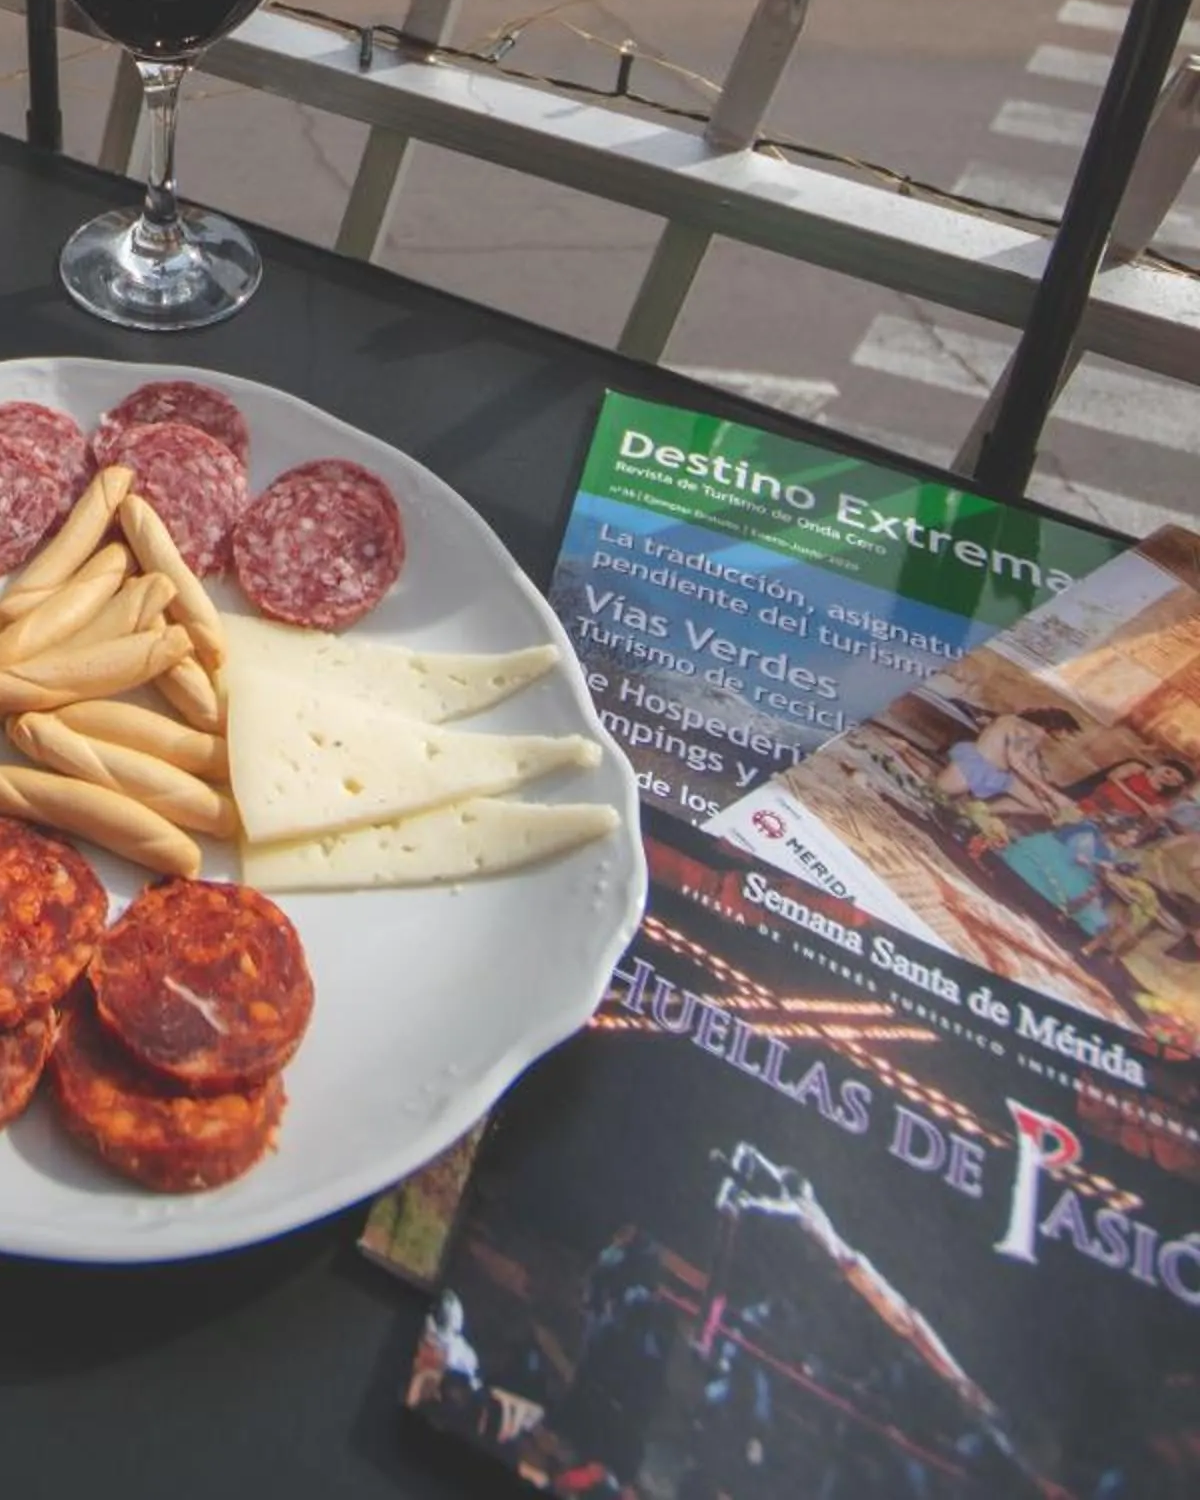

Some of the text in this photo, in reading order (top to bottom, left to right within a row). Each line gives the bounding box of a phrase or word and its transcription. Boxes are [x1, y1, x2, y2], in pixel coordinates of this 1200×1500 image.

[615, 460, 888, 556] Revista de Turismo de Onda Cero
[619, 429, 817, 509] Destino
[592, 549, 750, 617] pendiente
[757, 604, 809, 638] del
[599, 522, 635, 550] La
[644, 536, 816, 615] traducción,
[576, 613, 856, 734] Turismo de recicl
[584, 581, 840, 700] Vías Verdes
[635, 771, 722, 819] de los
[734, 759, 760, 788] y
[680, 883, 747, 926] FIESTA
[757, 922, 783, 945] DE
[742, 870, 1148, 1088] Semana Santa de Mérida
[603, 955, 1200, 1307] HUELLAS DE PASIÓ
